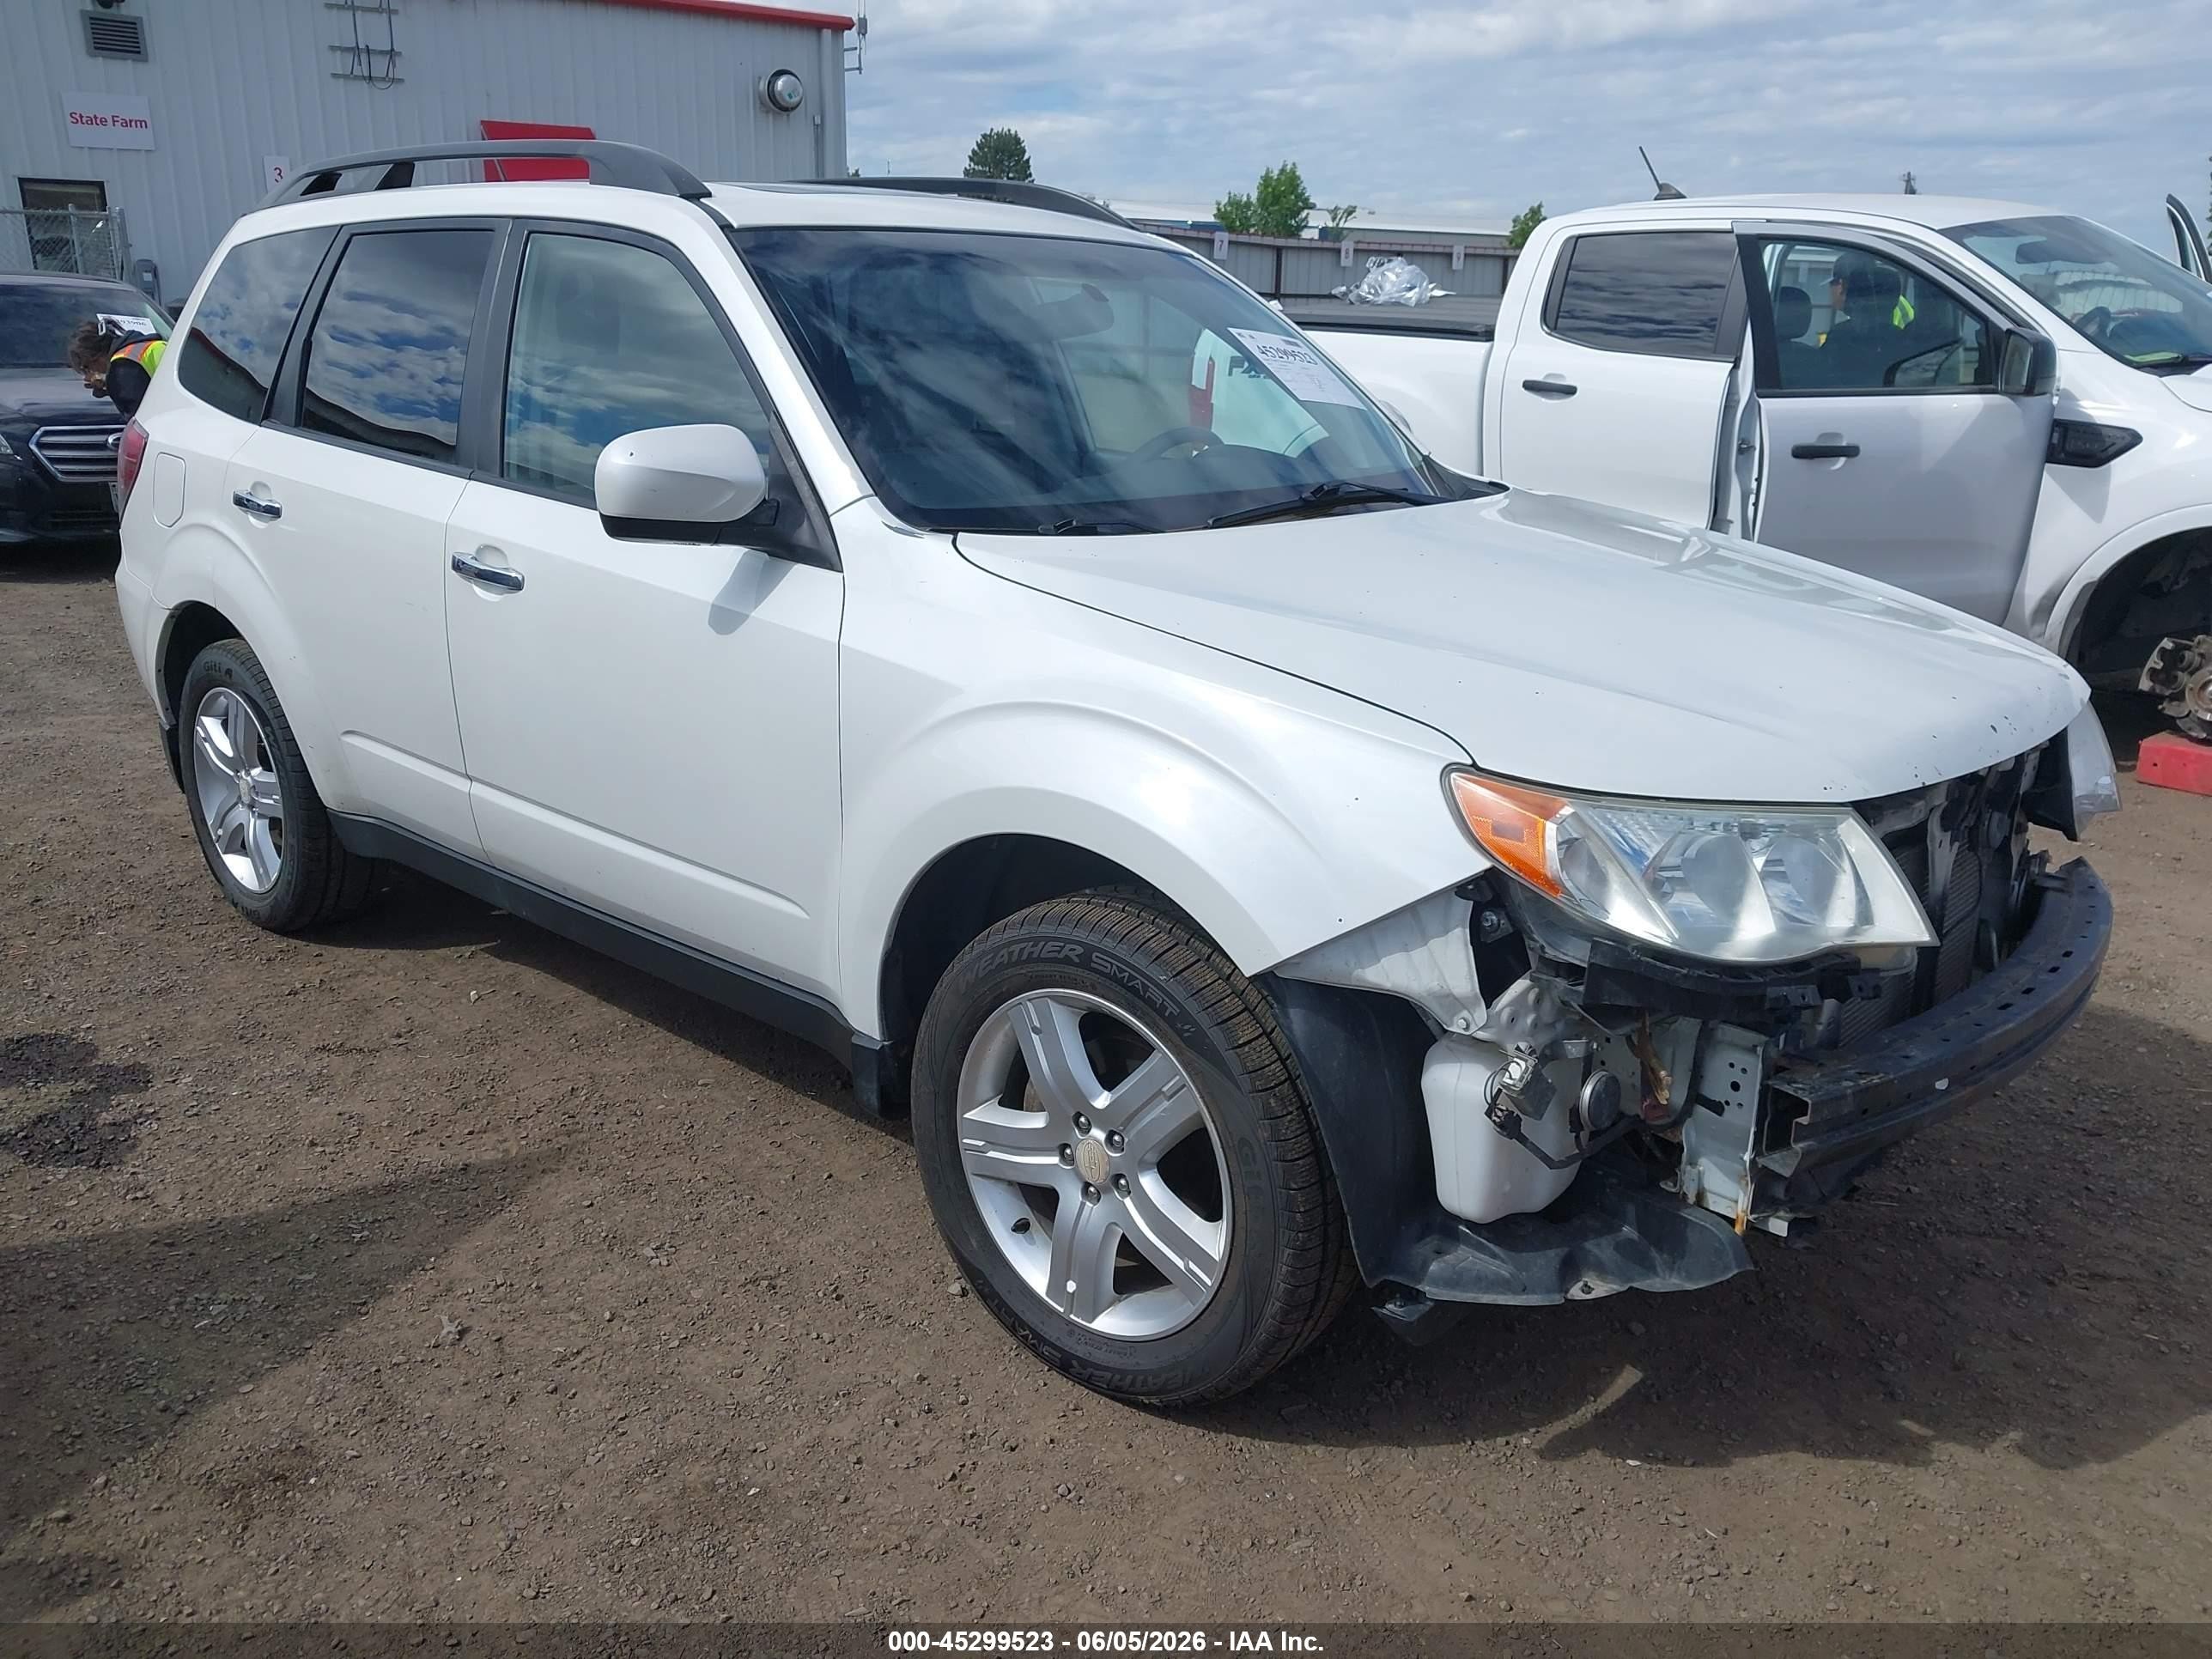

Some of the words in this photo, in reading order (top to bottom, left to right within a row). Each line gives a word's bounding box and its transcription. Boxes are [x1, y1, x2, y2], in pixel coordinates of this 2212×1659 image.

[70, 112, 108, 127] State
[111, 114, 148, 129] Farm
[274, 167, 283, 183] 3
[1219, 240, 1224, 252] 7
[1256, 345, 1319, 366] 45299523
[959, 941, 1085, 991] WEATHER
[1090, 951, 1181, 1018] SMART
